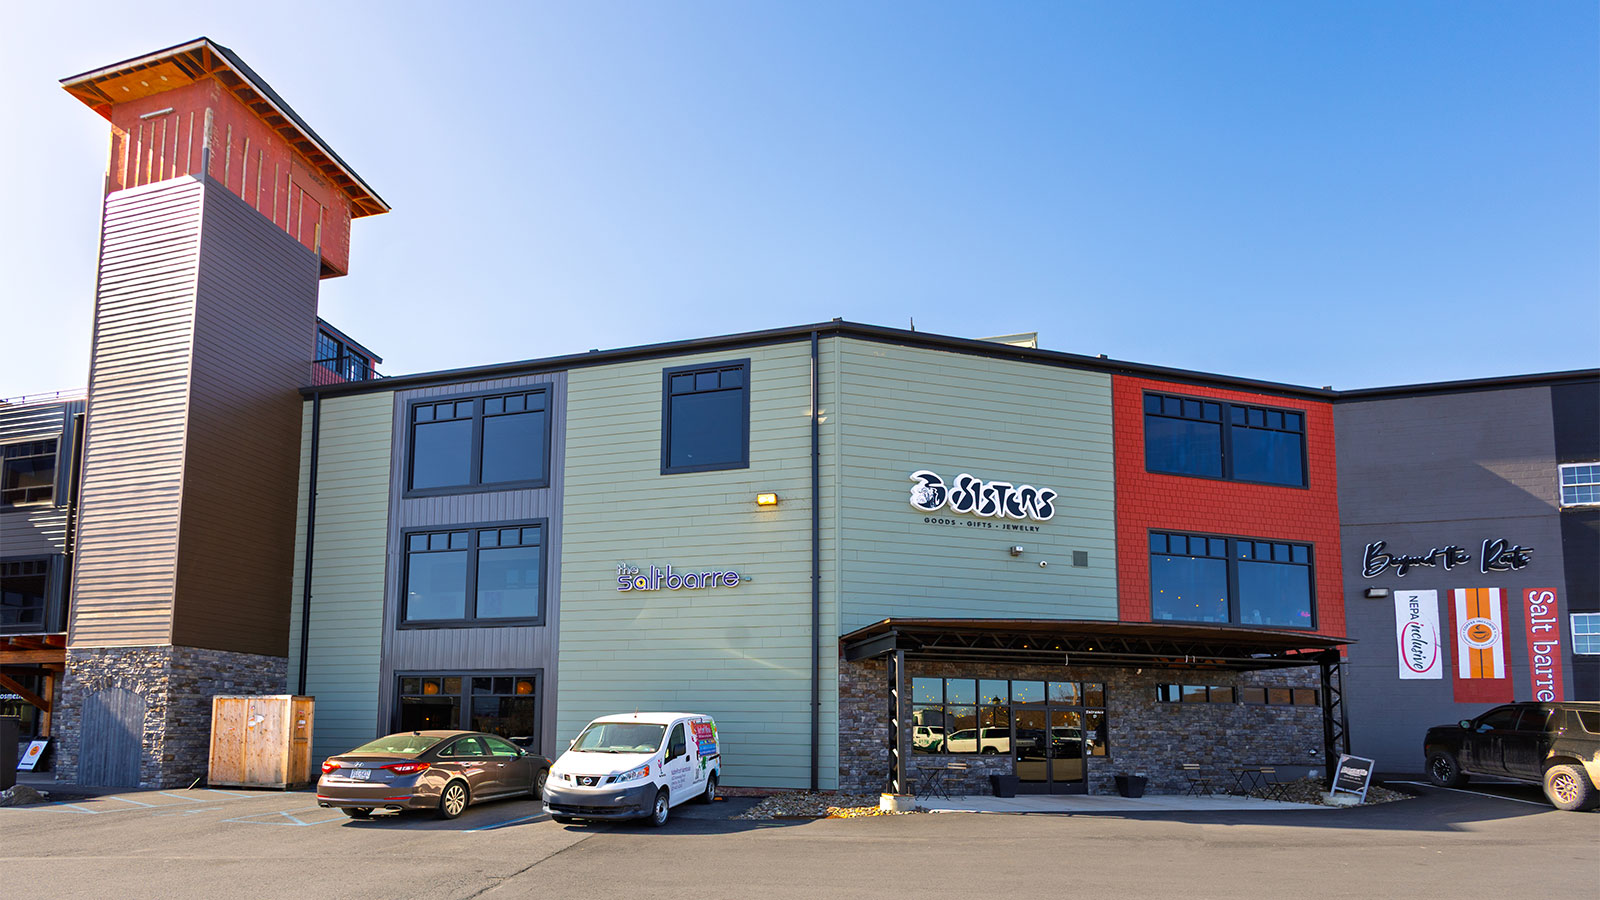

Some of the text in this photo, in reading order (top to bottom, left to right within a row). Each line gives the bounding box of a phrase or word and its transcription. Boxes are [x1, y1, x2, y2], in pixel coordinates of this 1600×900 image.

[924, 517, 1040, 532] GOODS GIFTS JEWELRY
[617, 561, 639, 575] the
[1408, 595, 1428, 670] NEPA inclusive
[1528, 590, 1559, 702] Salt barre
